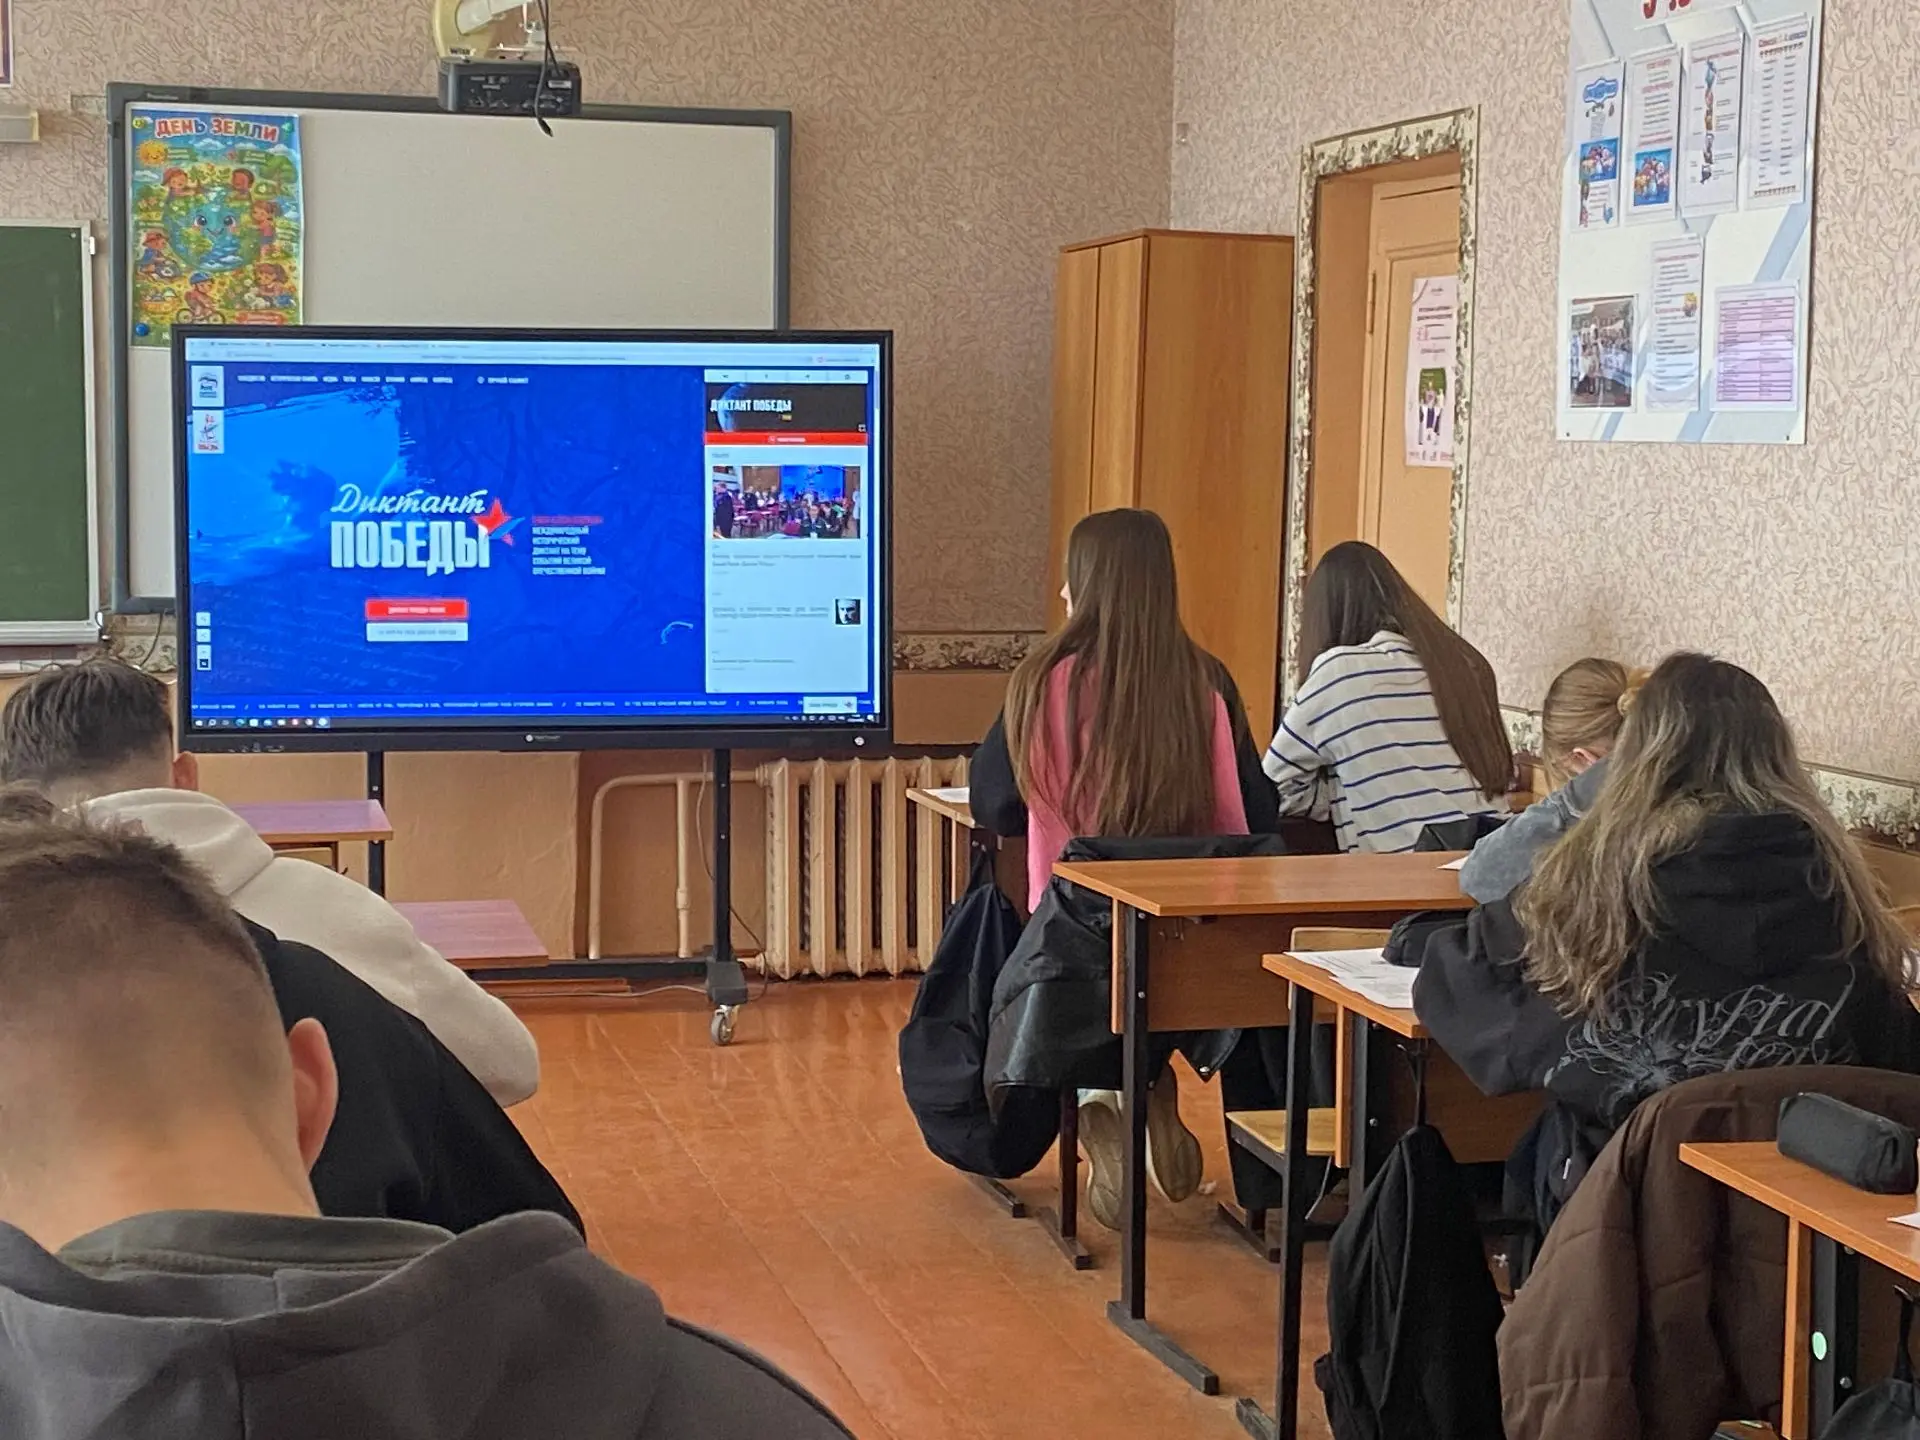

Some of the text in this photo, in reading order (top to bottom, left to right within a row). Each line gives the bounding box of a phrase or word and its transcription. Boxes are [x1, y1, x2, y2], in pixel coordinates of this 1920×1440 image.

[155, 118, 279, 142] ДЕНЬ ЗЕМЛИ
[710, 399, 792, 412] ДИКТАНТ ПОБЕДЫ
[330, 483, 488, 514] Диктант
[331, 520, 490, 577] ПОБЕДЫ
